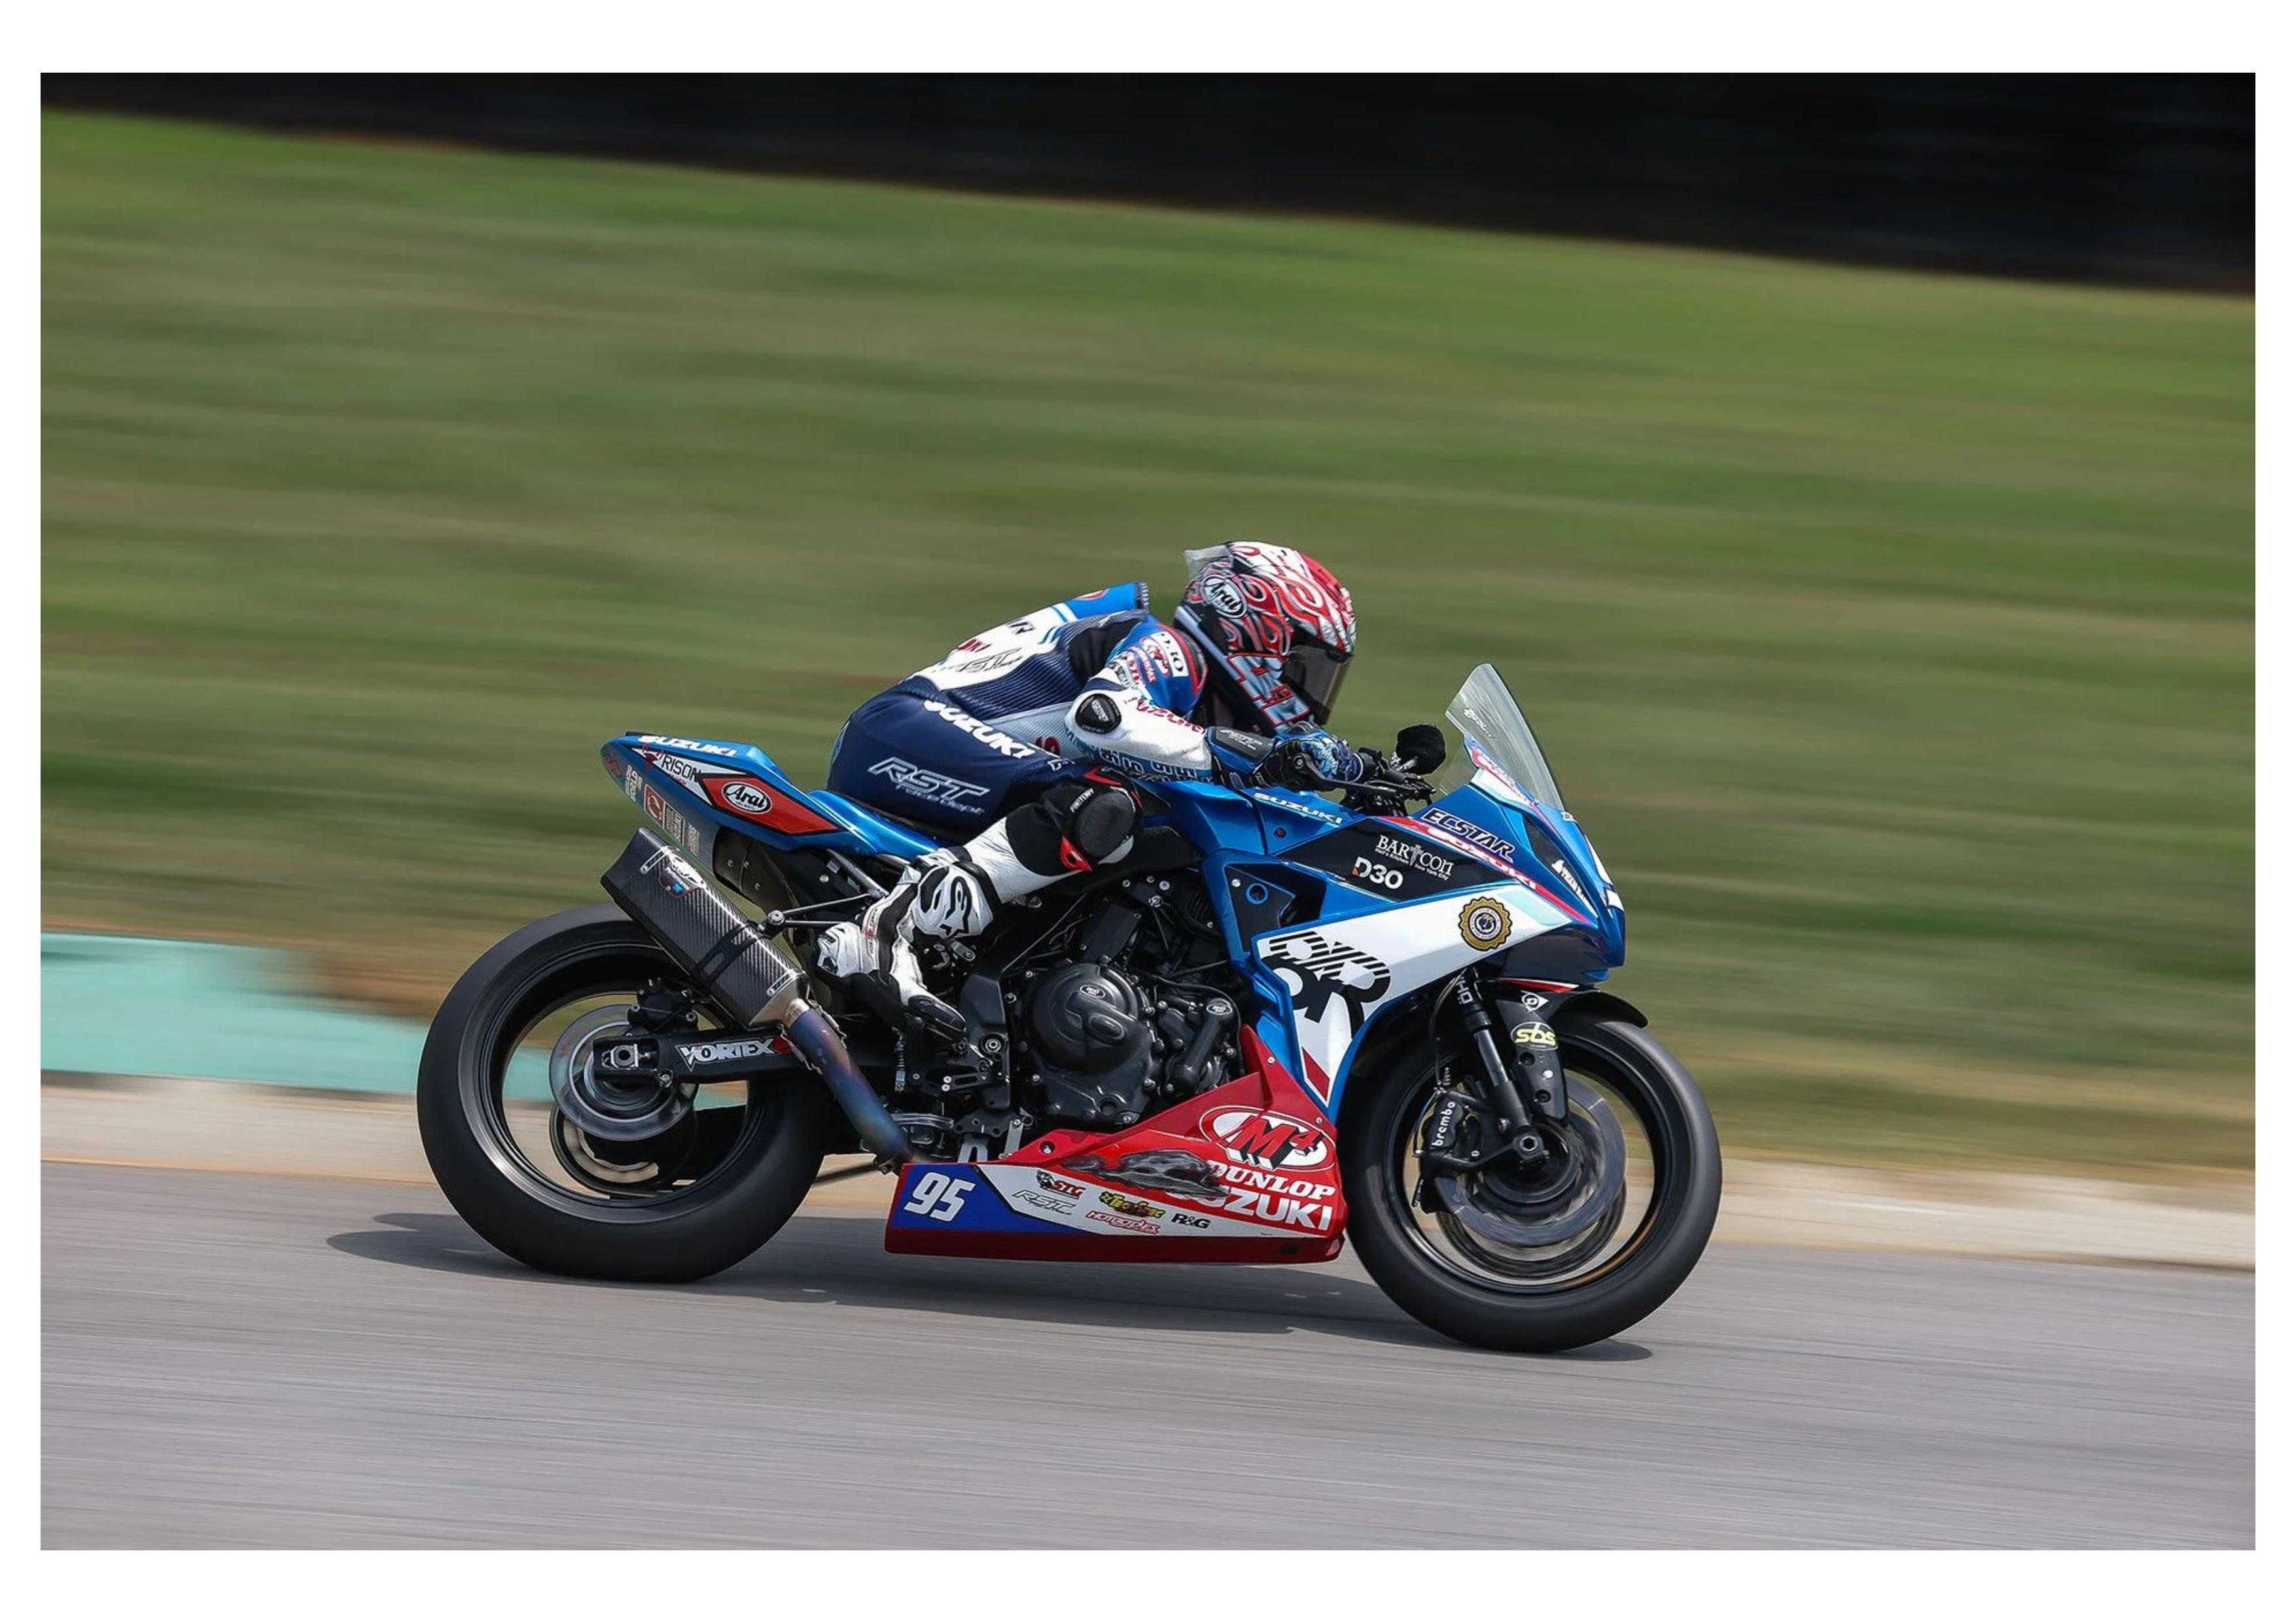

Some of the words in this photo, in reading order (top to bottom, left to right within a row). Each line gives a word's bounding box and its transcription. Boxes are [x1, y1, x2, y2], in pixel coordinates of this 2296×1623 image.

[923, 699, 1036, 759] SUZUKI
[637, 735, 737, 757] SUZUKI
[868, 756, 991, 802] RST
[726, 785, 766, 808] Arai
[1254, 792, 1343, 825] SUZUKI
[1420, 808, 1515, 864] ECSTAR
[1515, 1022, 1557, 1046] sbs
[680, 1038, 775, 1065] VORTEX
[1431, 1101, 1456, 1147] brembo
[903, 1171, 976, 1222] 95
[1207, 1160, 1336, 1200] DUNLOP
[1012, 1190, 1076, 1210] RST
[1171, 1213, 1210, 1229] R&G
